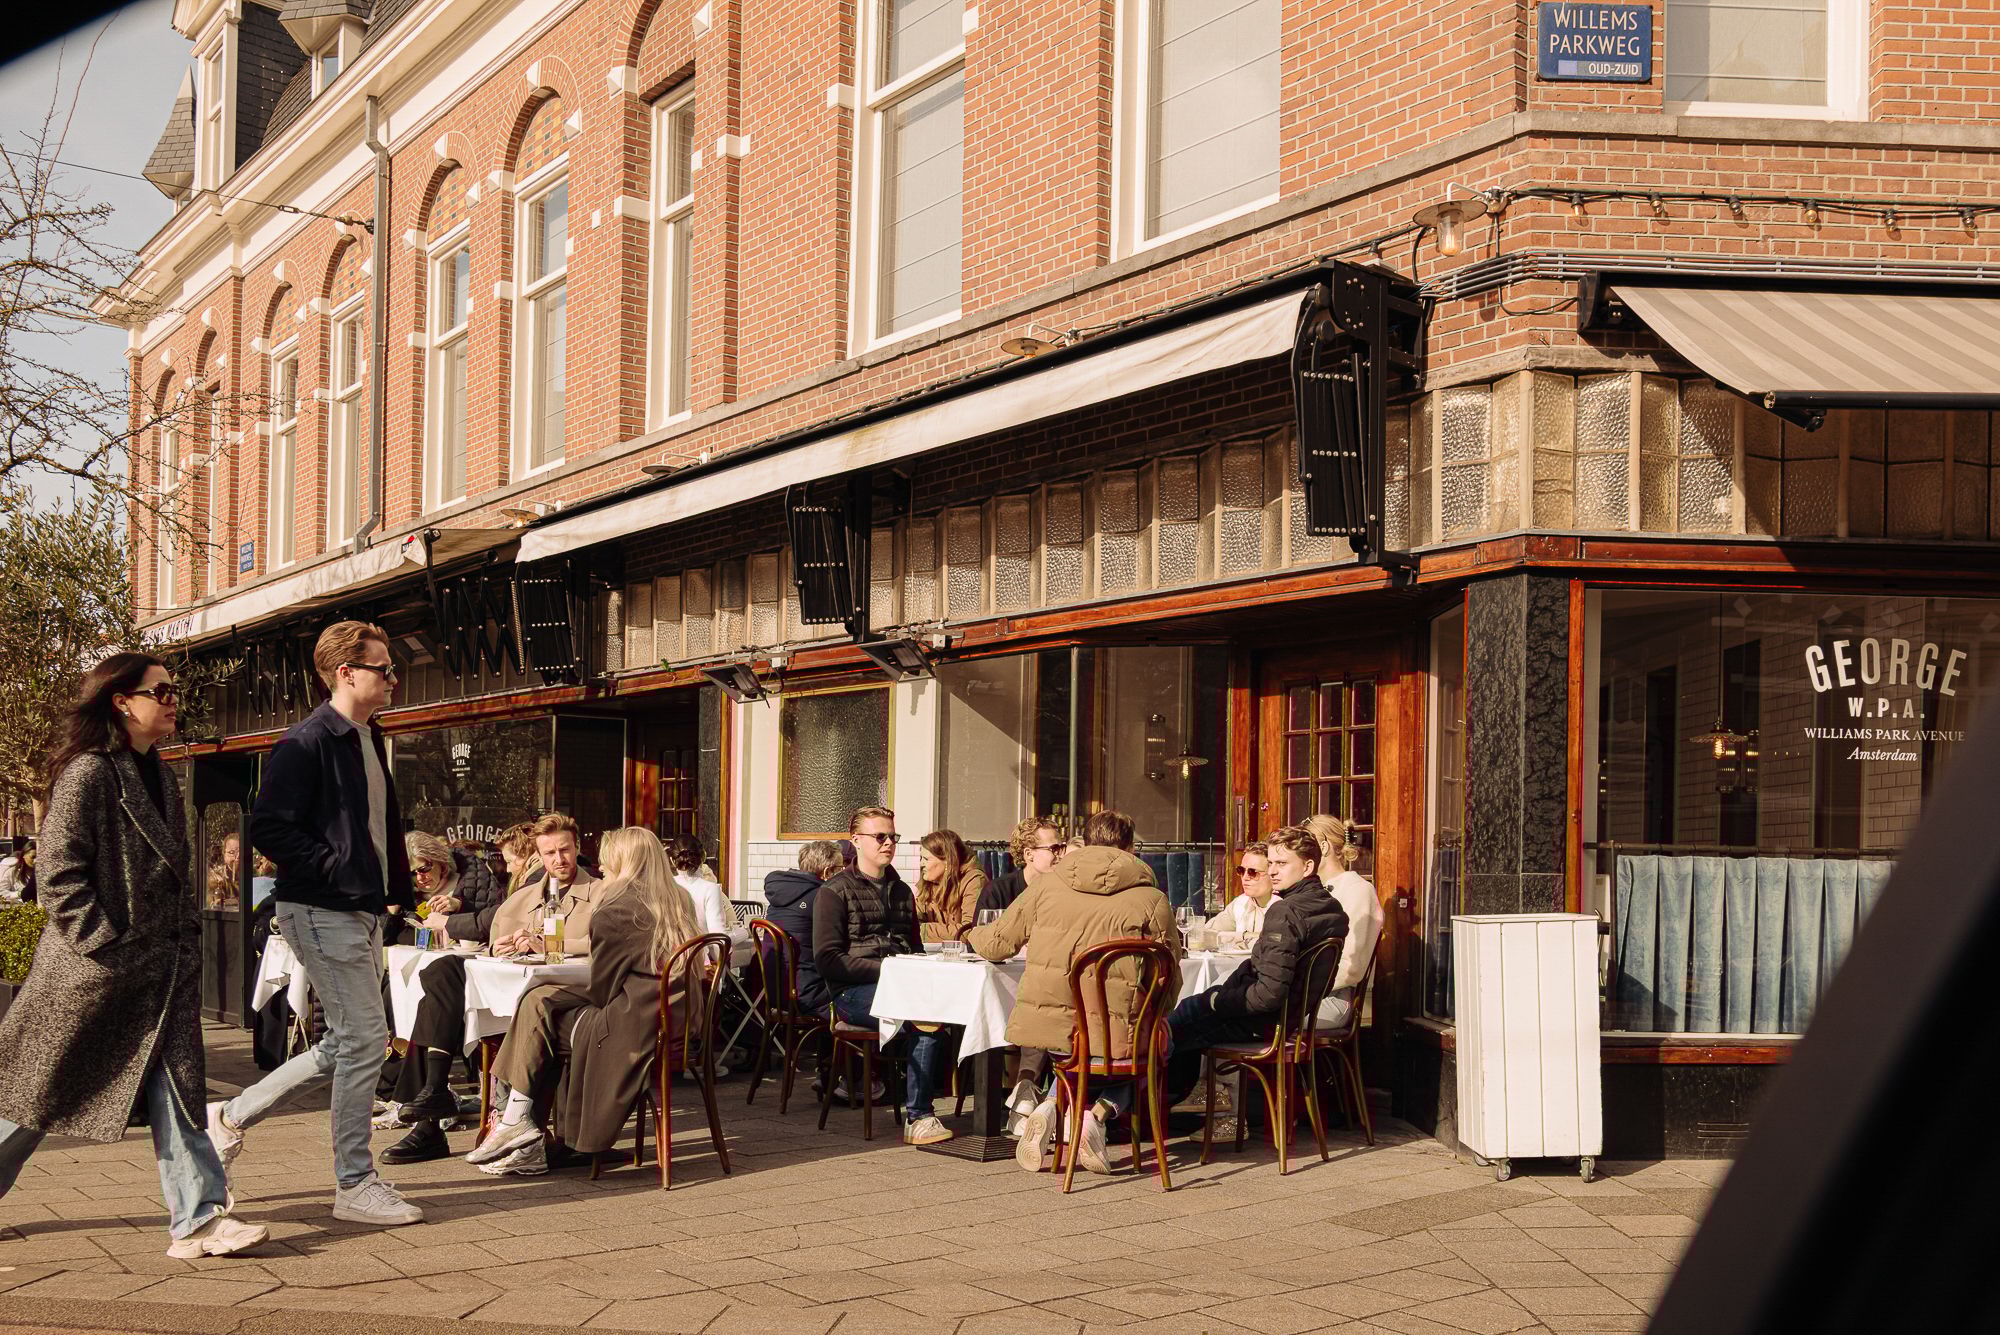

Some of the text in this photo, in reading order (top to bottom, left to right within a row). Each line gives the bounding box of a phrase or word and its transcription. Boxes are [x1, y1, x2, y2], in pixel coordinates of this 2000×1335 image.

[1554, 8, 1638, 31] WILLEMS
[1550, 34, 1640, 56] PARKWEG
[1588, 62, 1639, 76] OUD-ZUID
[1805, 637, 1967, 697] GEORGE
[1848, 697, 1925, 719] W.P.A.
[1804, 727, 1965, 742] WILLIAMS PARK AVENUE
[1847, 747, 1918, 761] Amsterdam
[446, 823, 503, 844] GEORGE
